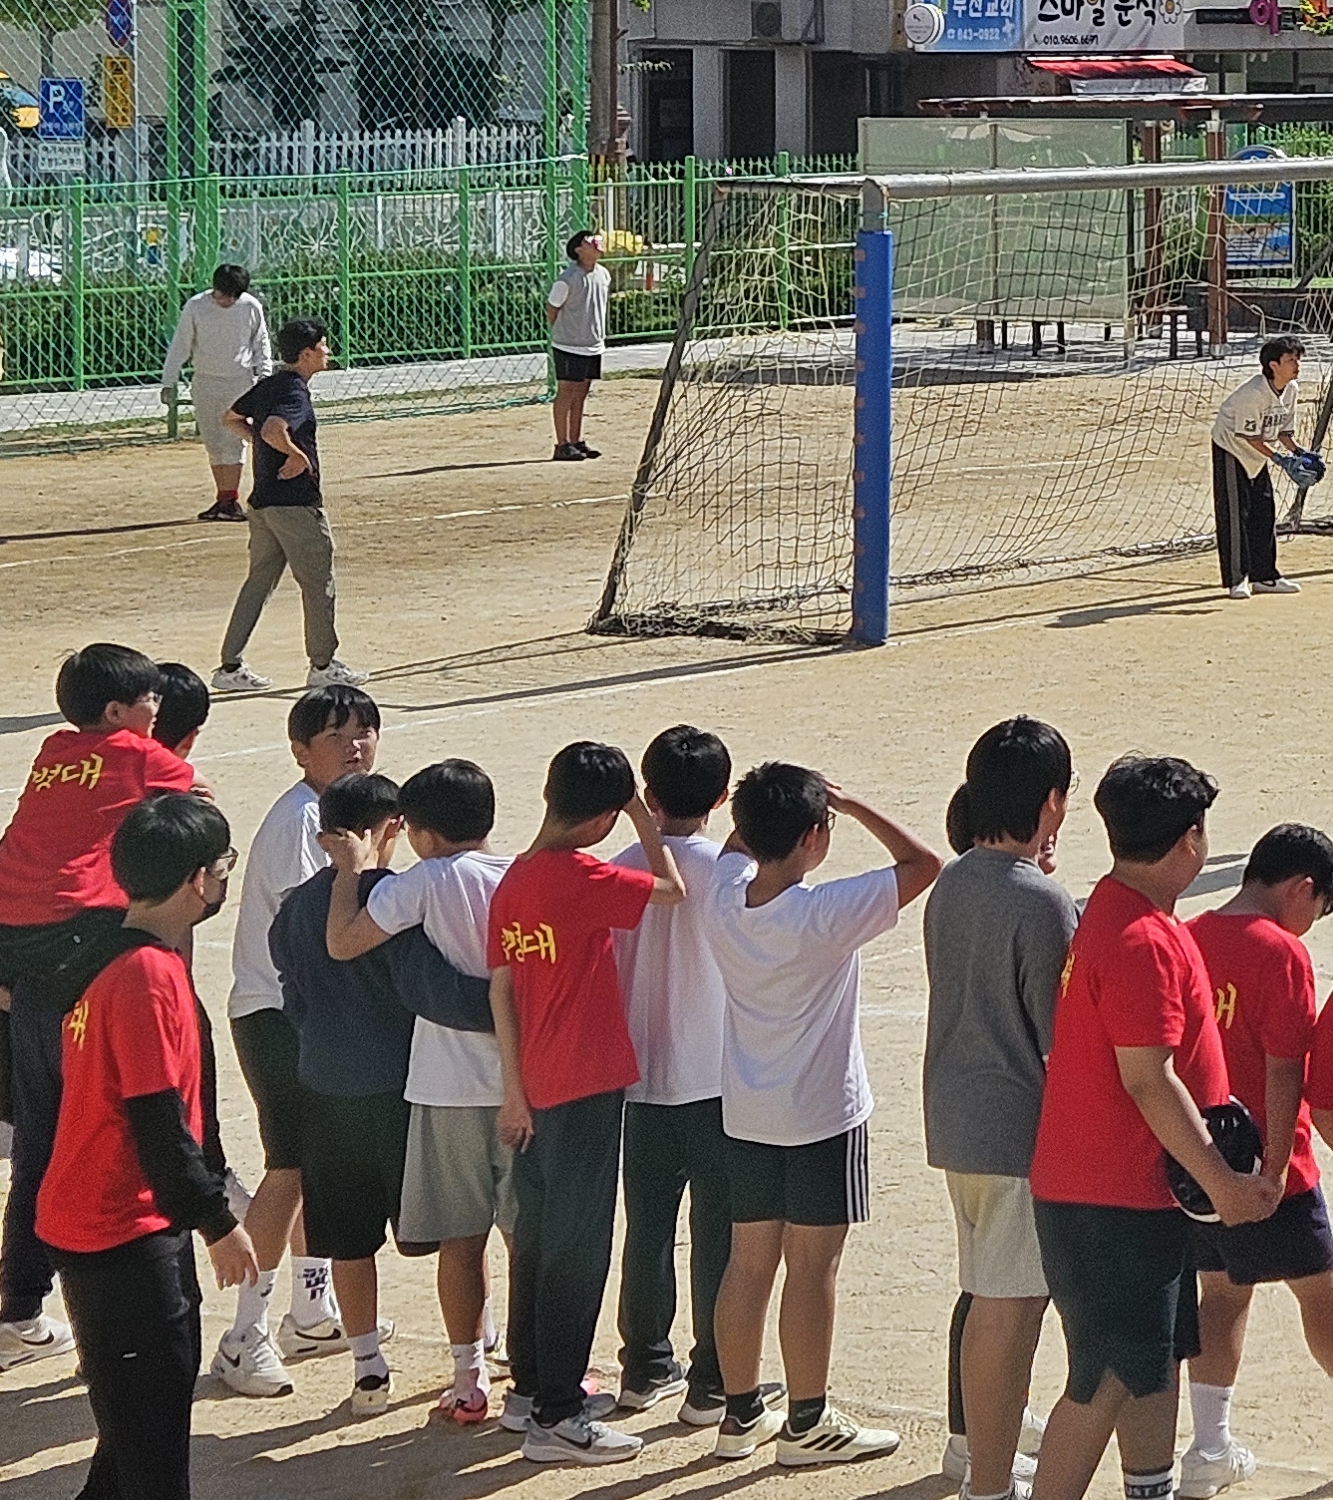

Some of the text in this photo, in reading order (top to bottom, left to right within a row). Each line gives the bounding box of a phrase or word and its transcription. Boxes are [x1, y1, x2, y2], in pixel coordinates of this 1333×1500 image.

[32, 753, 103, 792] 병대
[501, 921, 557, 965] 병대
[1126, 1485, 1151, 1498] UST
